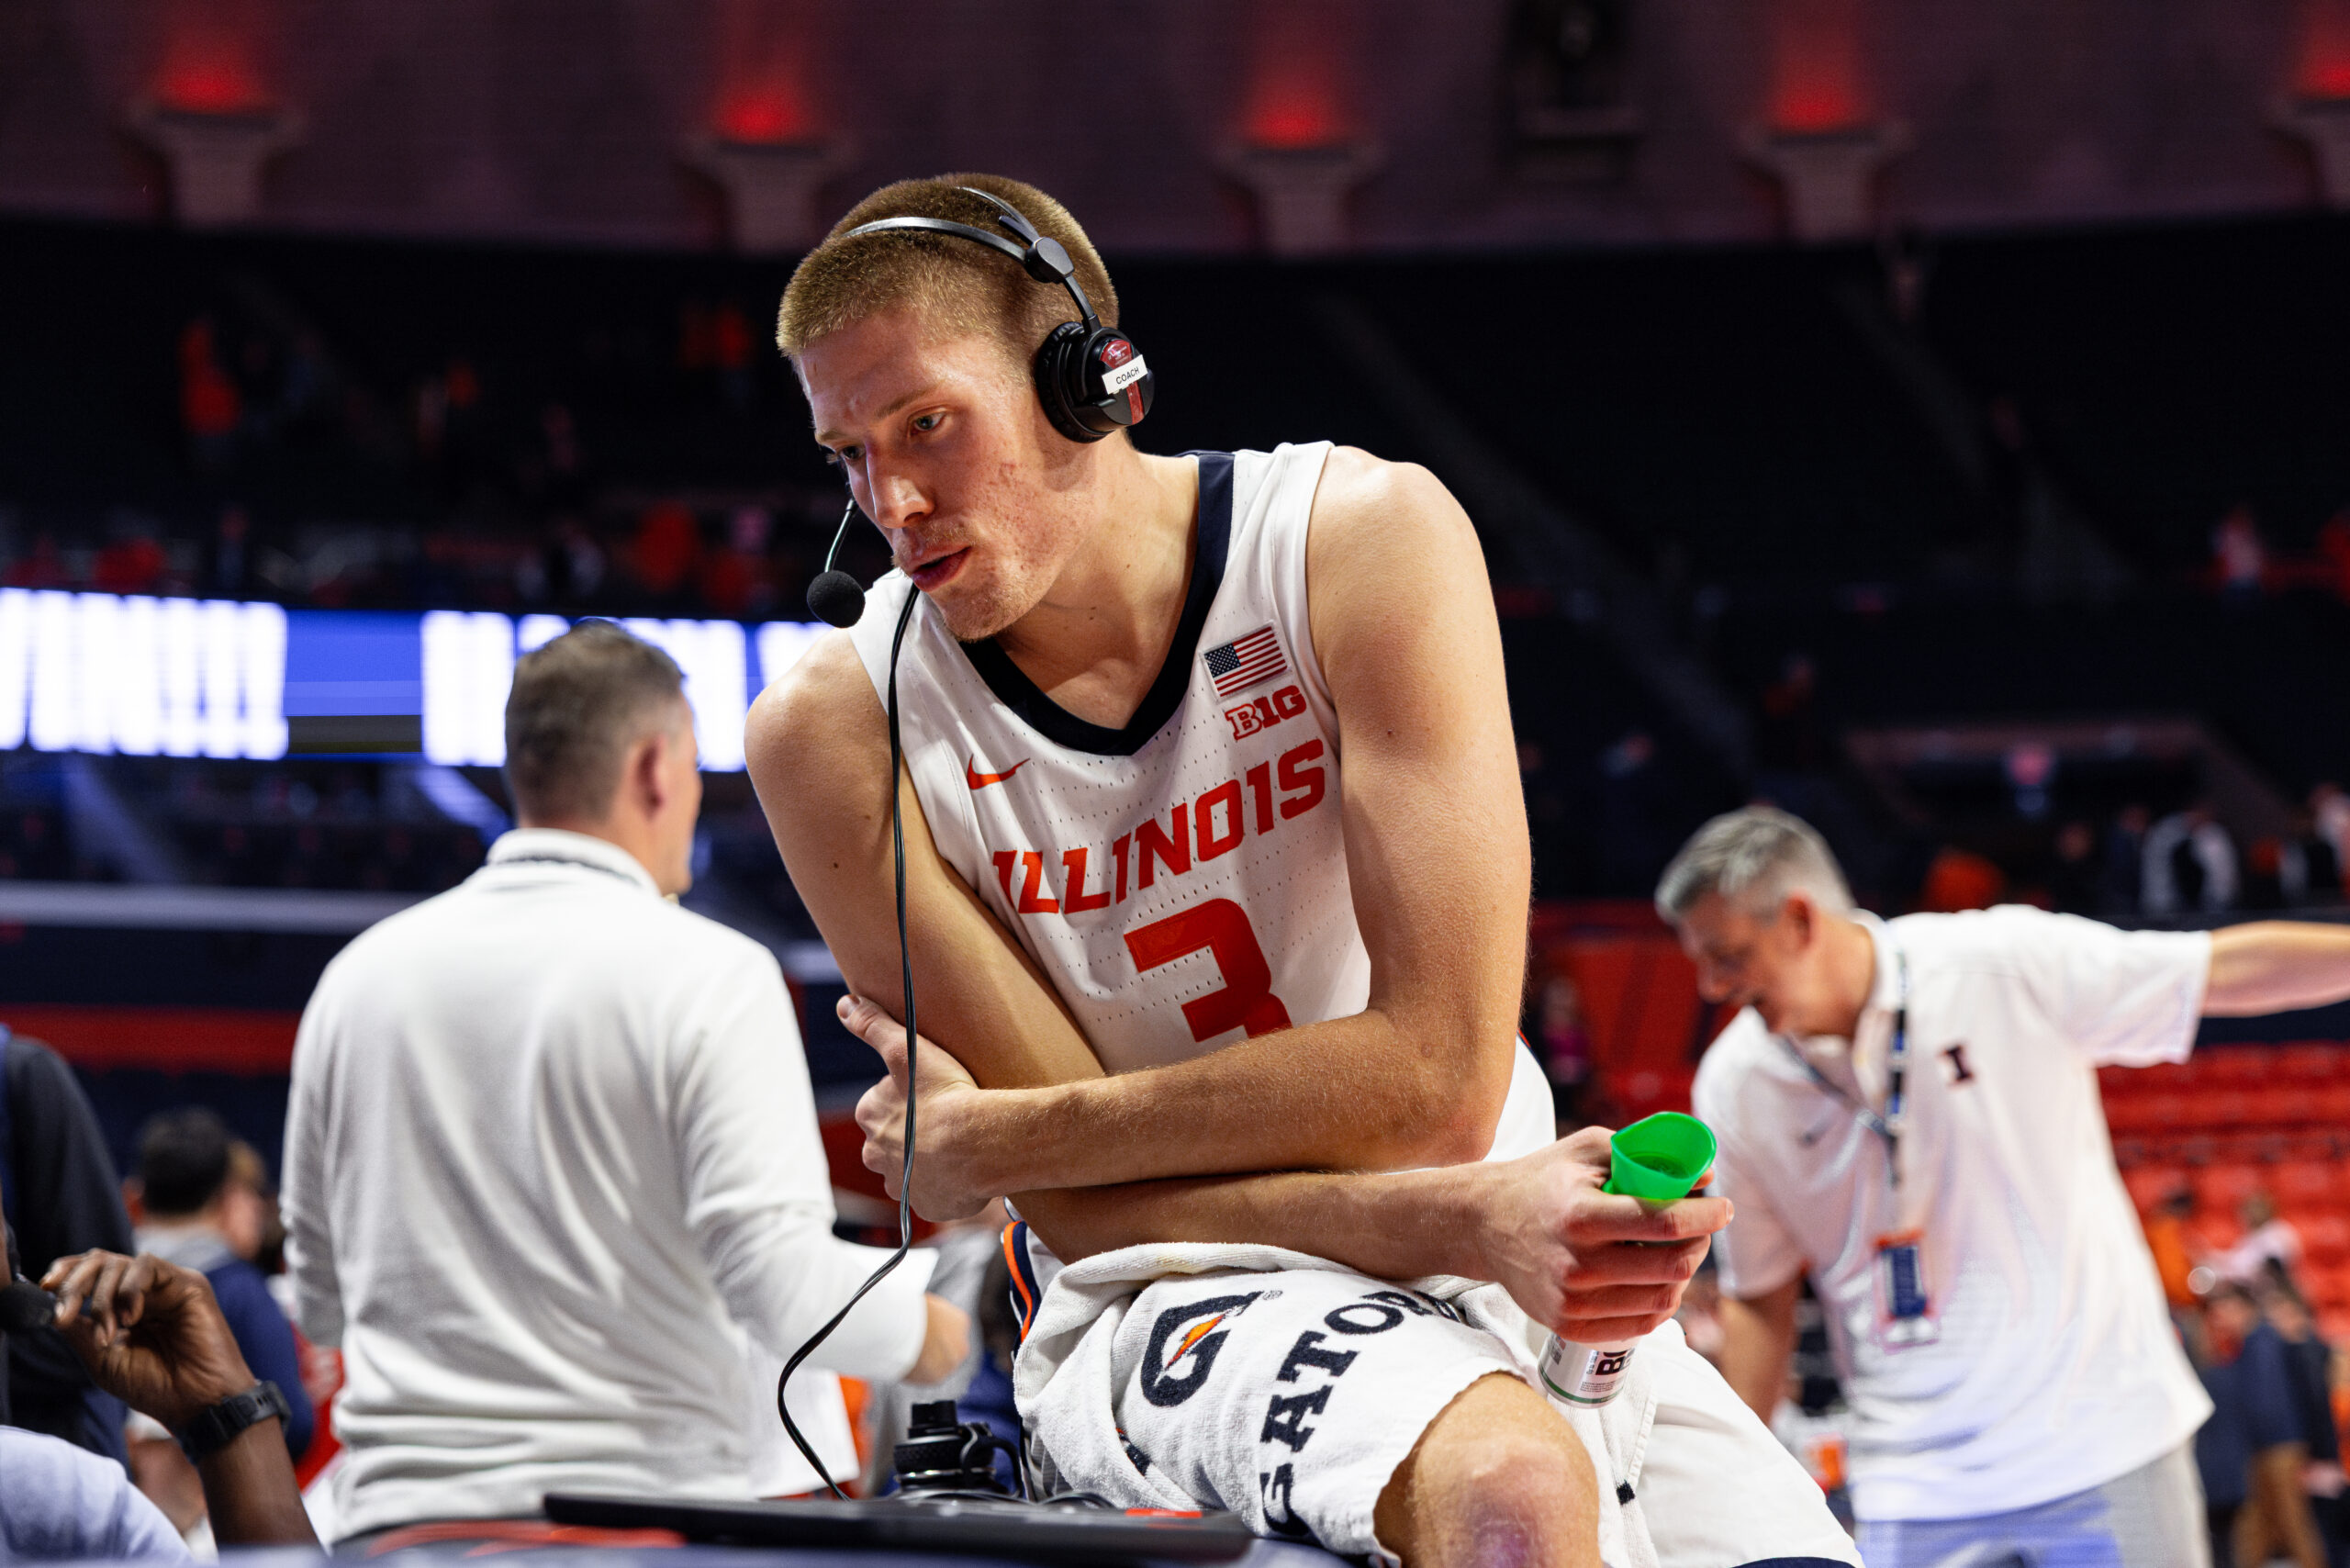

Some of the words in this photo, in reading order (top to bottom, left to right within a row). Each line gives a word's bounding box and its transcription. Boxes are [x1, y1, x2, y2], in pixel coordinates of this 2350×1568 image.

[1115, 366, 1140, 385] COACH
[992, 739, 1326, 914] ILLINOIS
[1124, 898, 1292, 1044] 3
